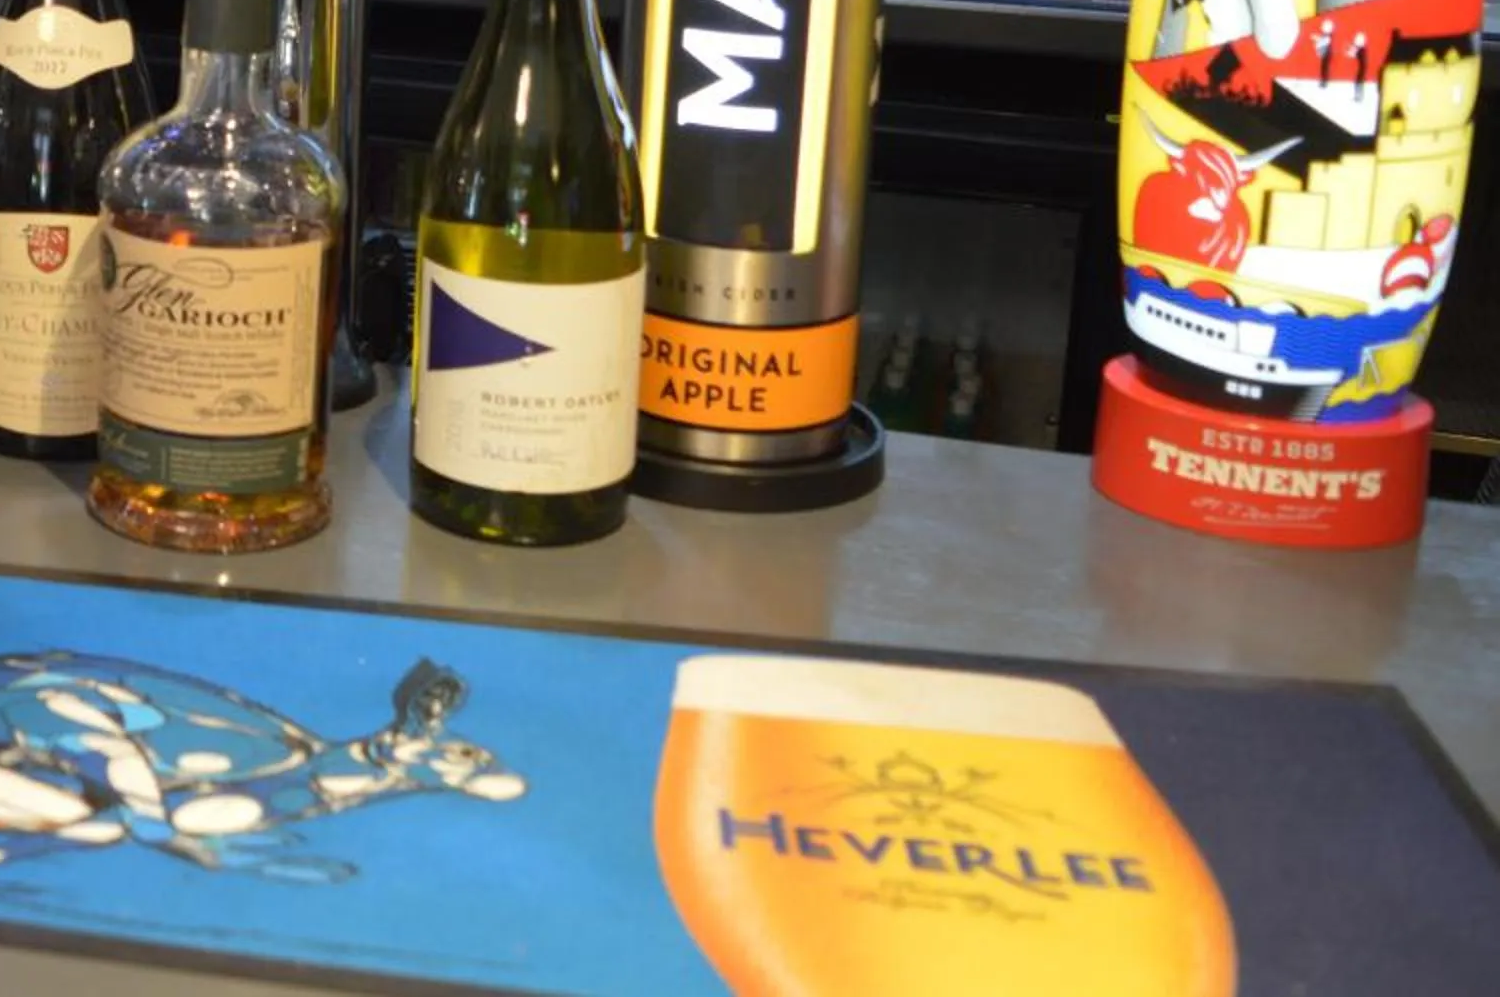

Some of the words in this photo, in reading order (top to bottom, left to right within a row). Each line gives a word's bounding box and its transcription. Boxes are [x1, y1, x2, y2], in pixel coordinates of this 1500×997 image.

[112, 262, 195, 314] Glen
[723, 287, 796, 302] CIDER
[138, 301, 286, 328] GARIOCH
[480, 390, 556, 409] ROBERT
[659, 377, 768, 412] APPLE
[1147, 437, 1386, 500] TENNENT'S
[719, 807, 1156, 900] HEVERLEE
